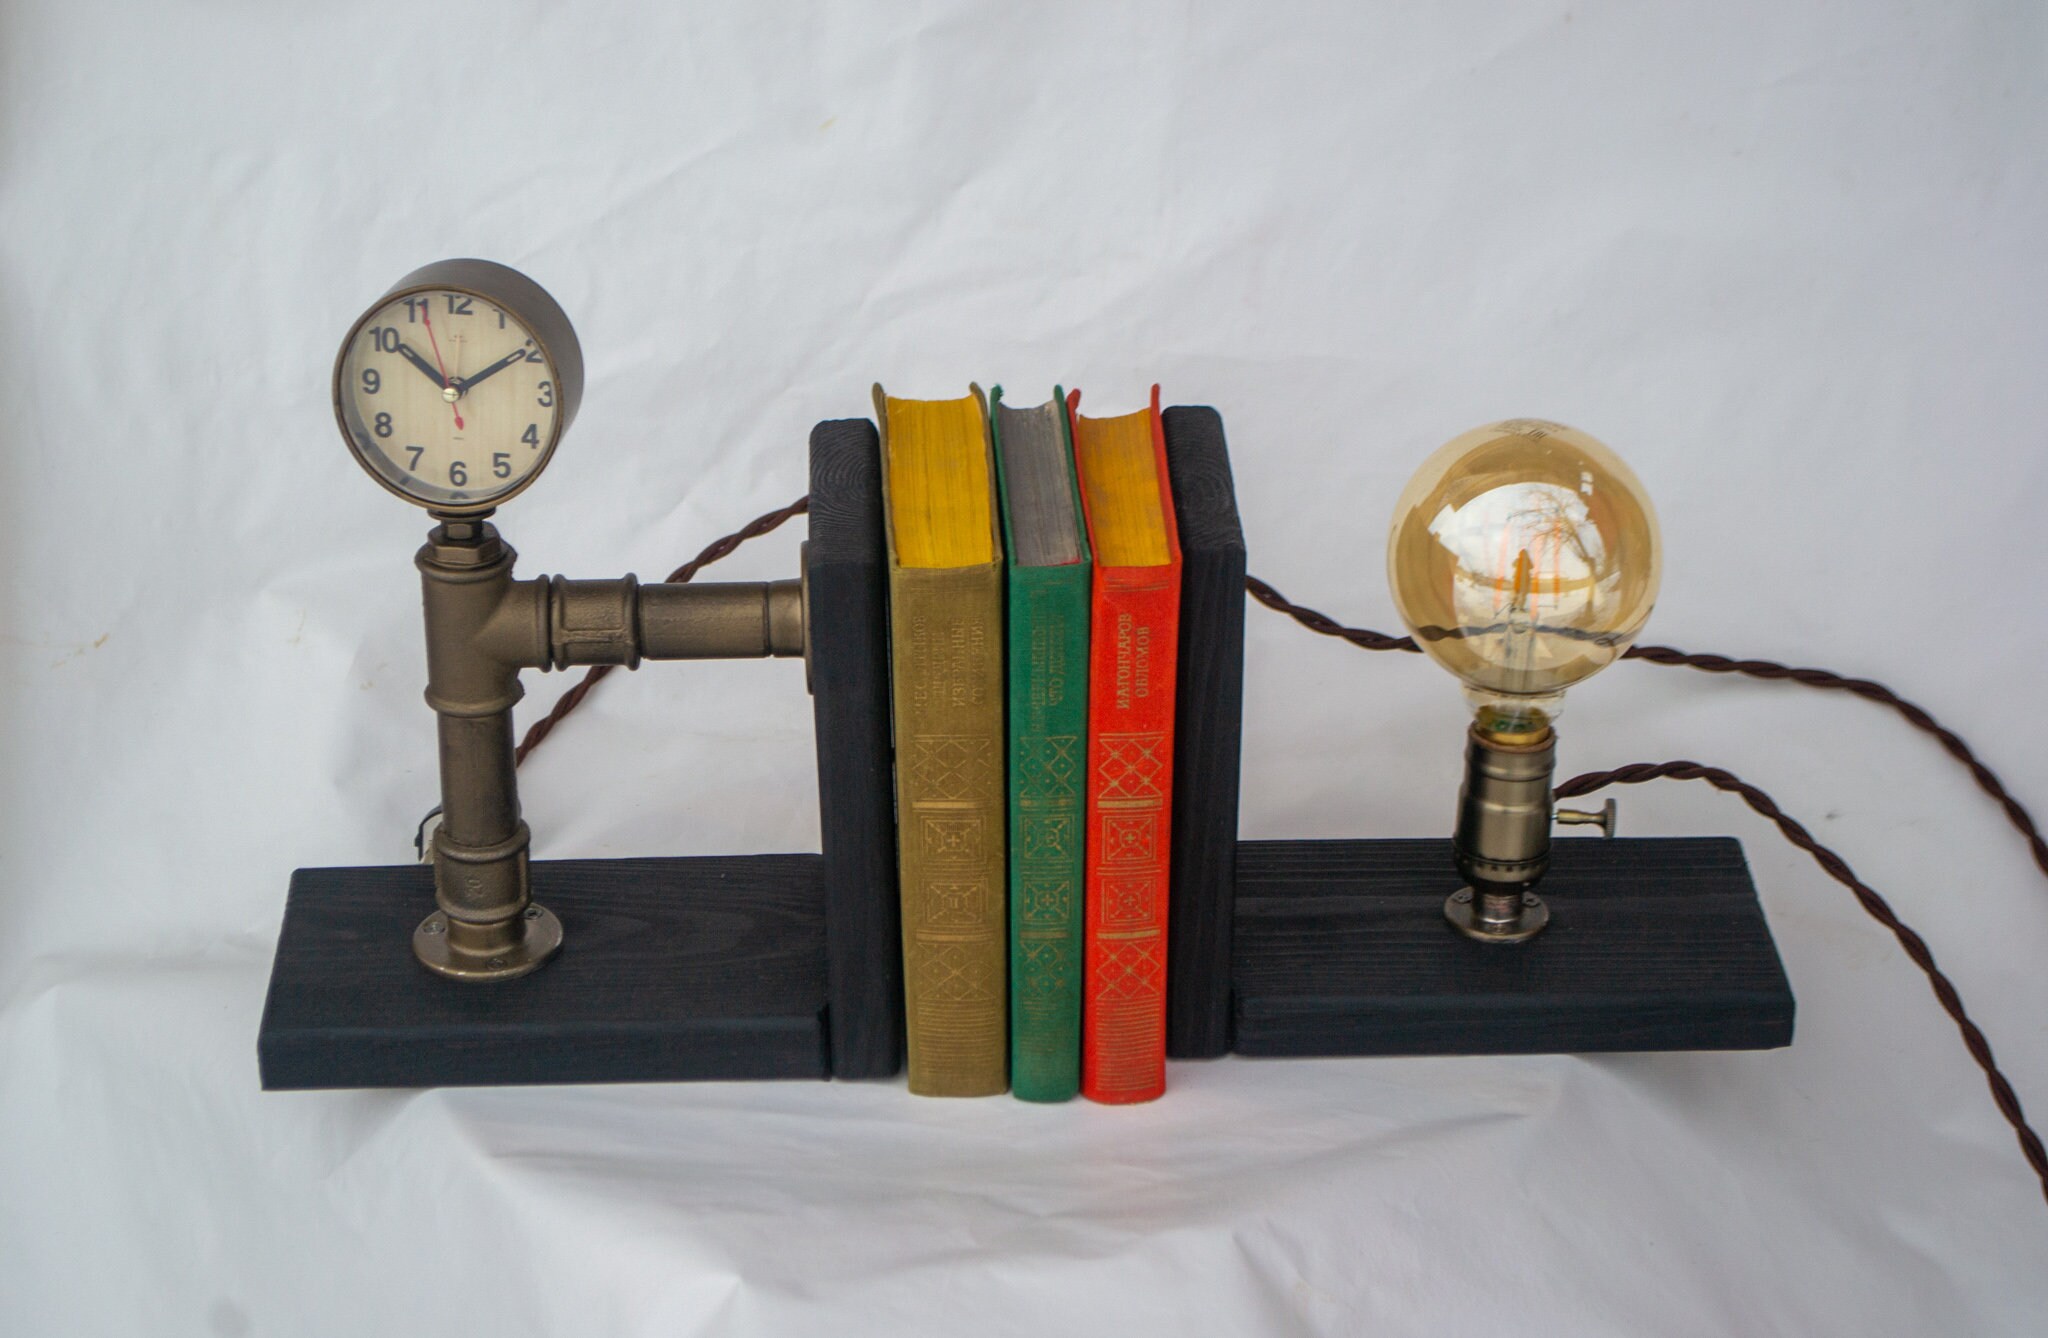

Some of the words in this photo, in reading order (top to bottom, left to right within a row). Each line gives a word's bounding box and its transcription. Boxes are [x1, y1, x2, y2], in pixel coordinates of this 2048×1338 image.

[402, 296, 429, 323] 11
[442, 294, 473, 315] 12
[492, 308, 506, 329] 1
[368, 326, 400, 353] 10
[524, 338, 544, 363] 2
[361, 368, 380, 394] 9
[537, 381, 553, 407] 3
[374, 412, 393, 438] 8
[521, 424, 540, 449] 4
[405, 446, 424, 471] 7
[492, 453, 511, 478] 5
[449, 461, 467, 487] 6
